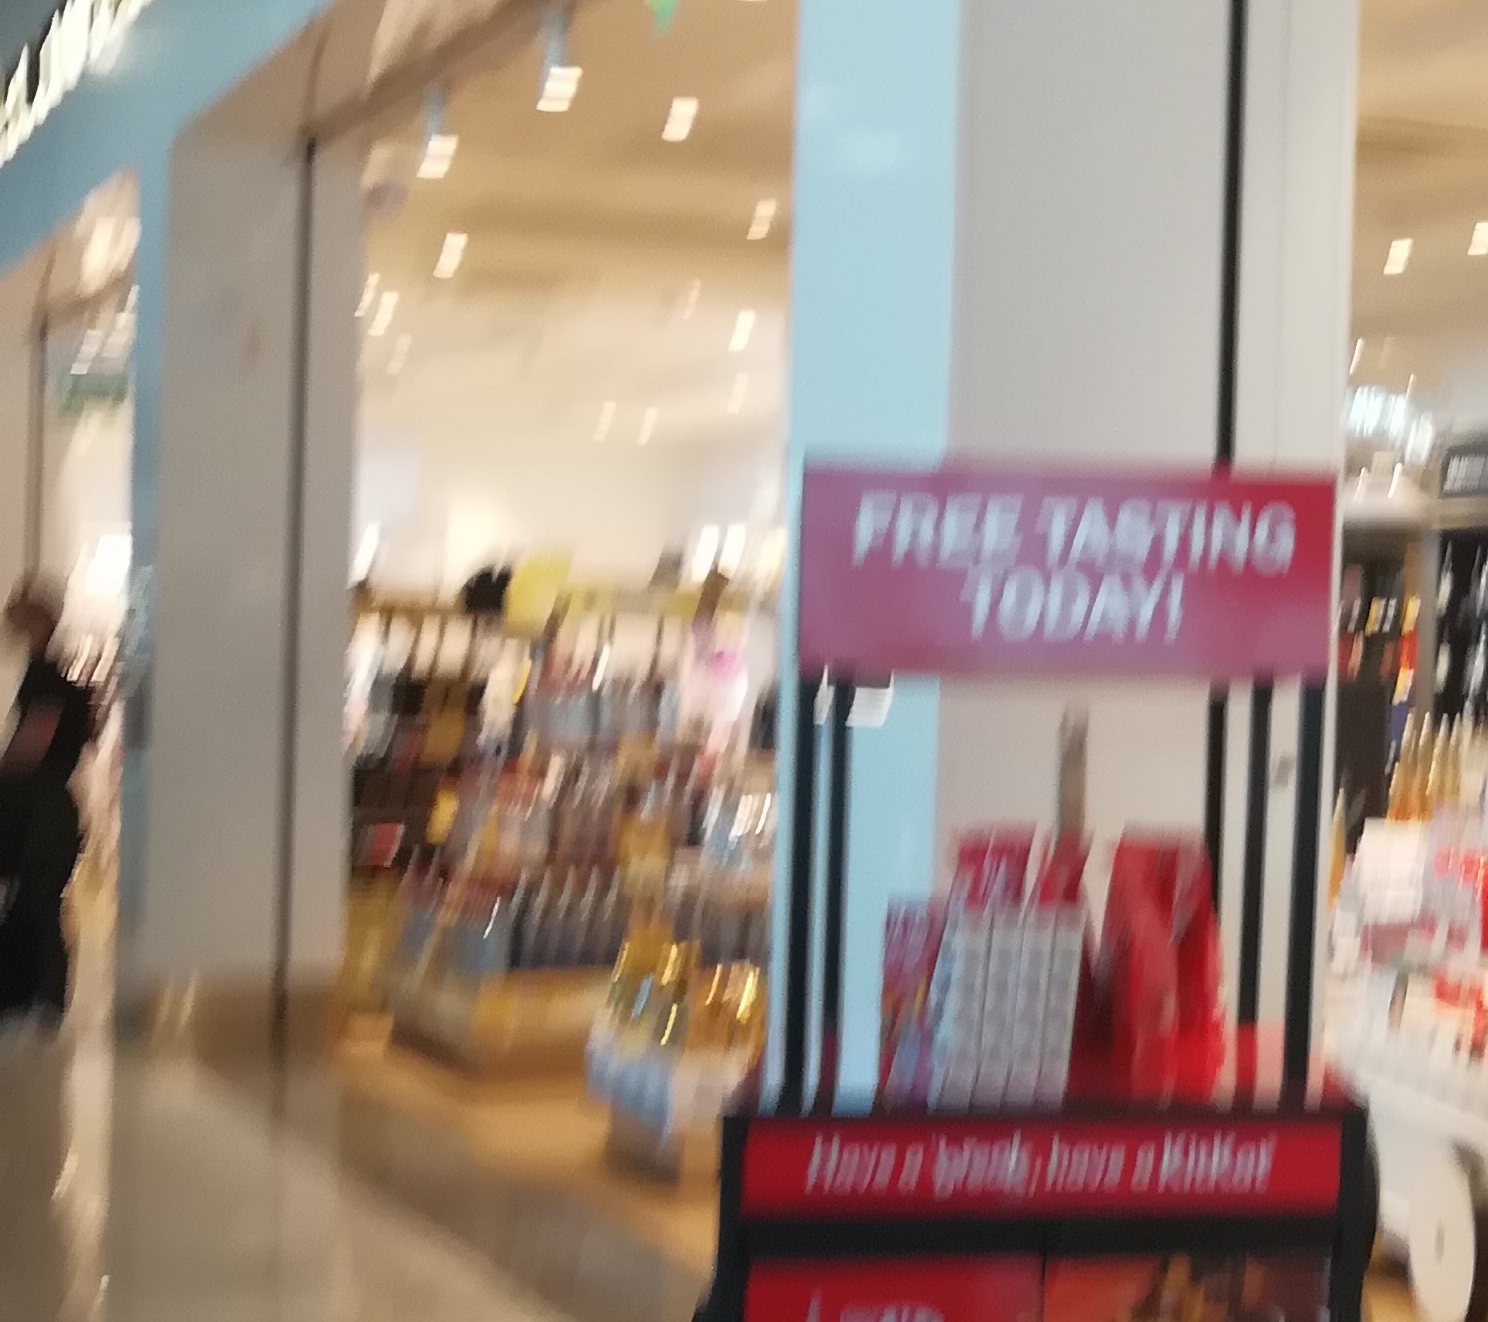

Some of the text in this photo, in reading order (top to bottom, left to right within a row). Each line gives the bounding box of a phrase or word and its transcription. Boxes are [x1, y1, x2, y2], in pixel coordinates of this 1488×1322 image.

[850, 490, 1297, 576] FREE TASTING
[960, 566, 1184, 645] TODAY!
[805, 1131, 897, 1196] Have
[898, 1141, 924, 1196] a
[1046, 1133, 1126, 1194] have
[1131, 1141, 1156, 1194] a
